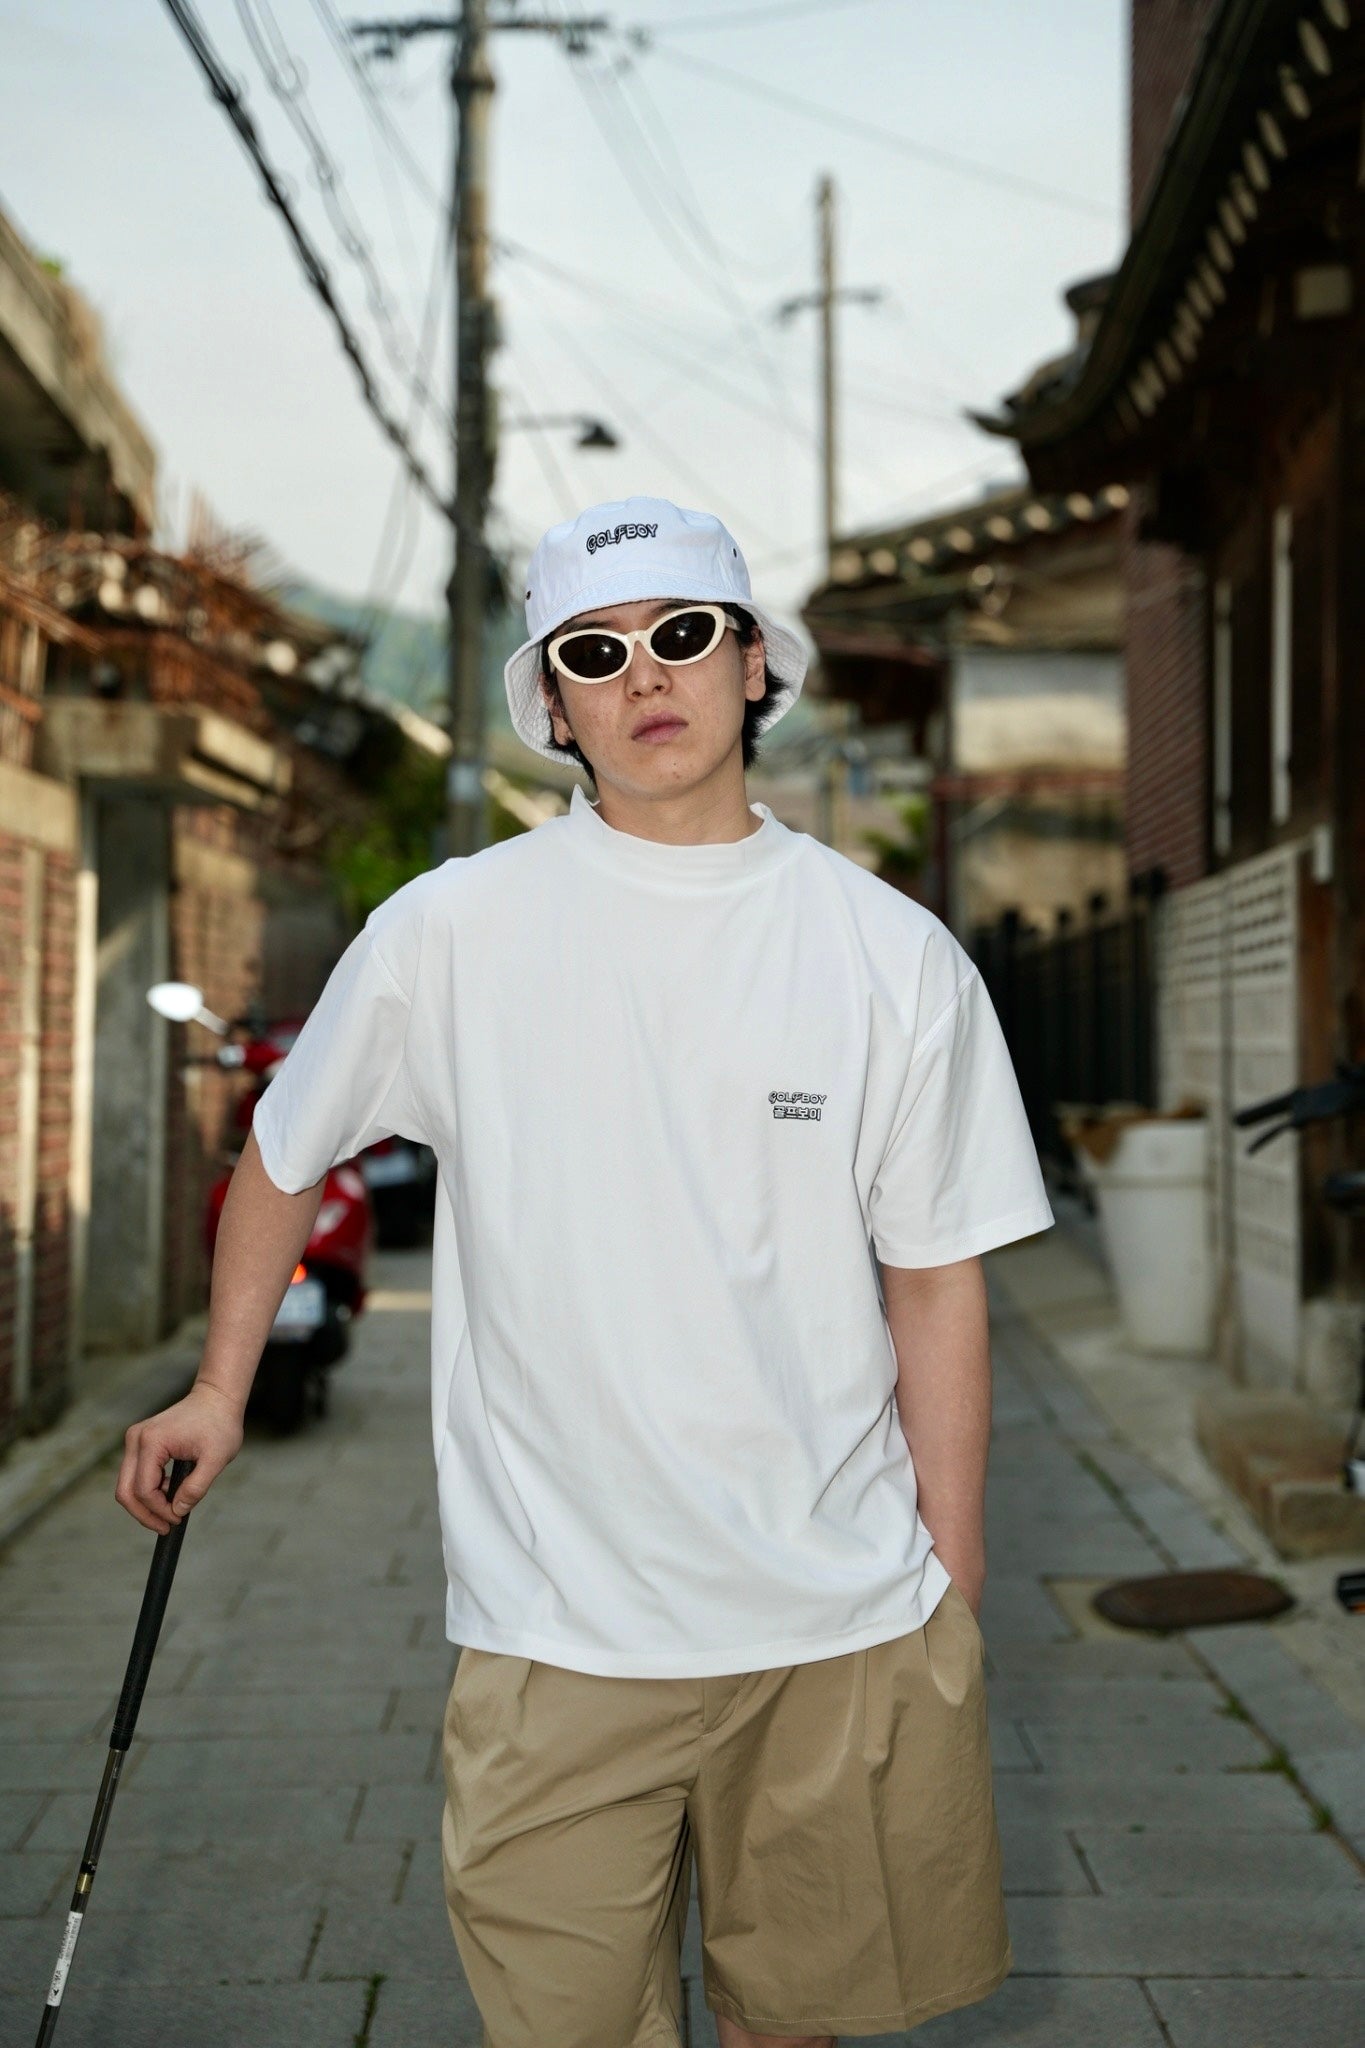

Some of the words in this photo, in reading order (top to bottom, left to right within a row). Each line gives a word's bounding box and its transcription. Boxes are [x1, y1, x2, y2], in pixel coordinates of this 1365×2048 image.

[586, 523, 658, 555] GOLFBOY
[768, 1091, 827, 1104] GOLFBOY
[773, 1105, 821, 1121] 골프보이
